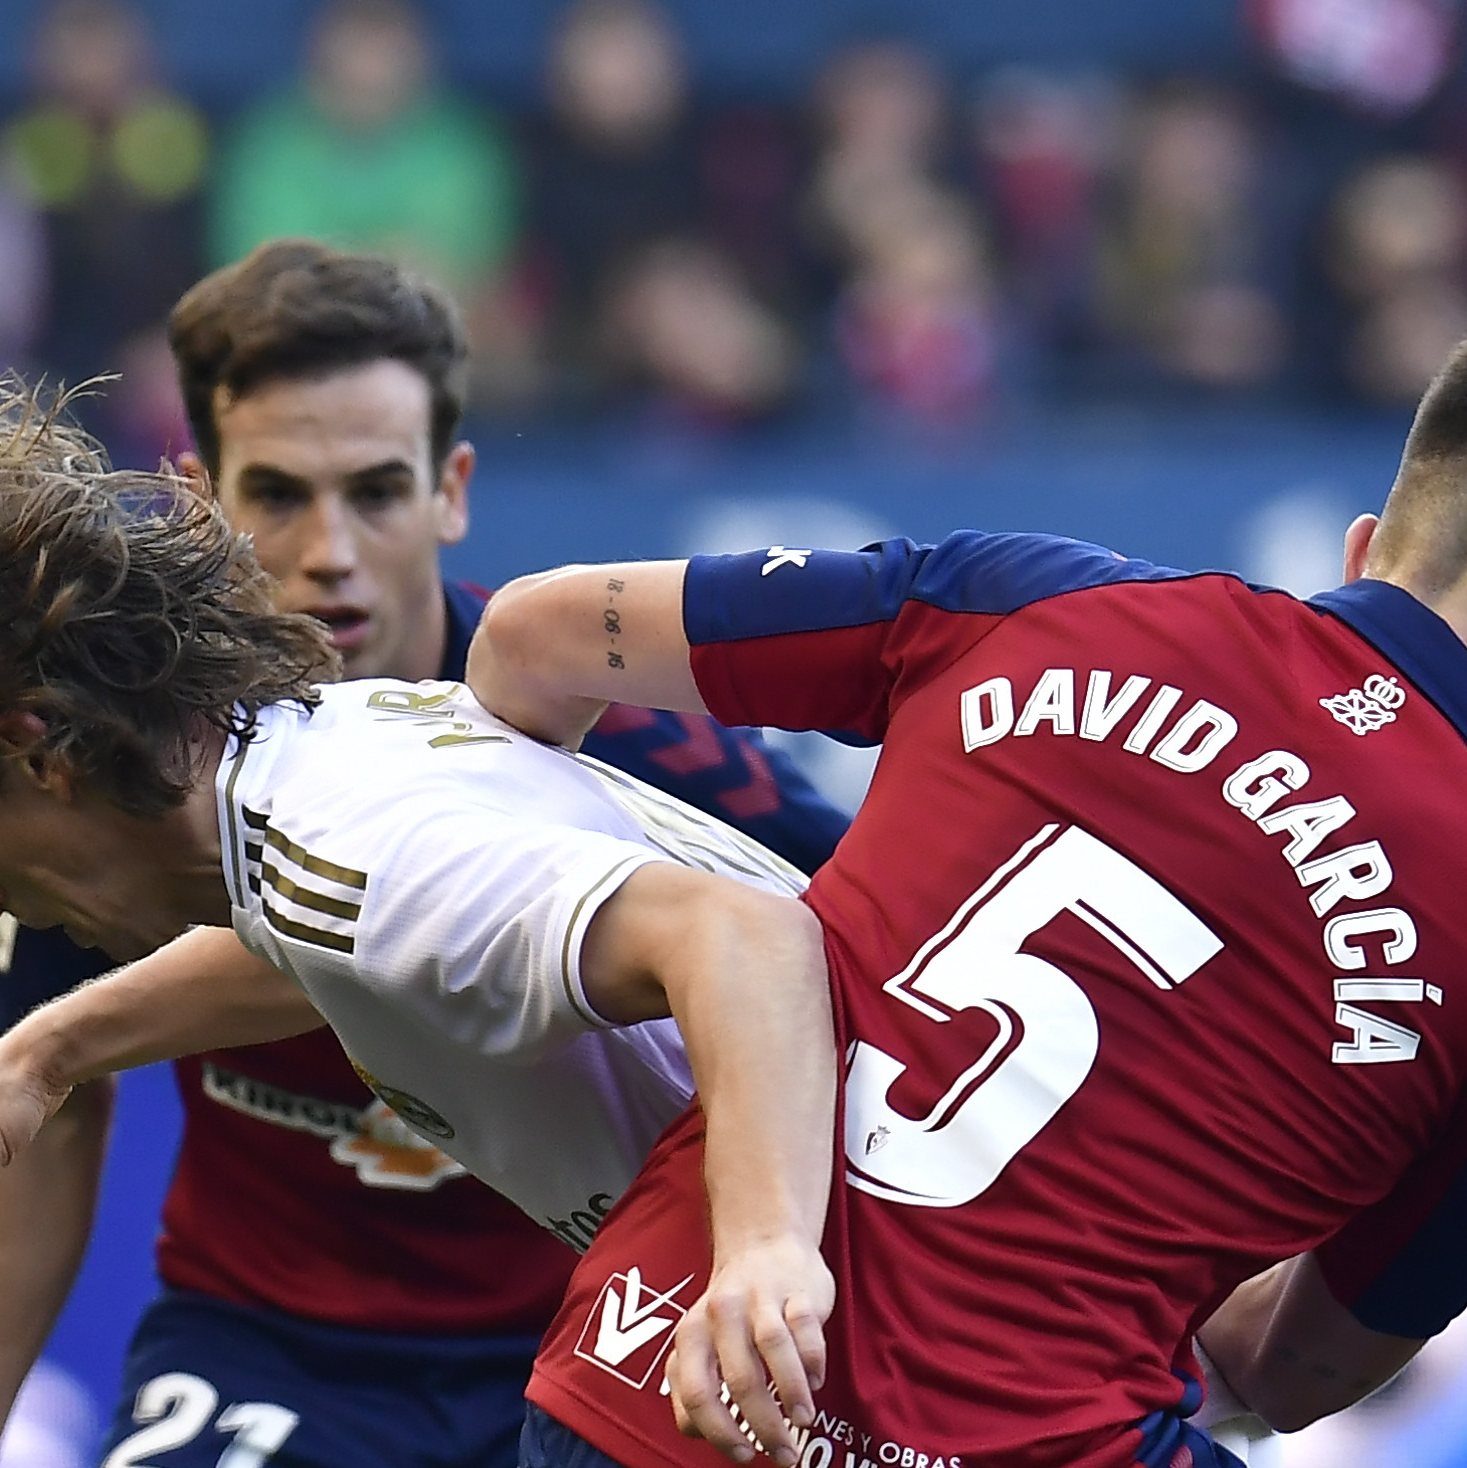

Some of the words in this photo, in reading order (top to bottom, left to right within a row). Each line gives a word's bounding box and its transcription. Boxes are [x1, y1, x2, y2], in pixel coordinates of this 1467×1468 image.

[844, 822, 1226, 1208] 5
[959, 667, 1239, 776] DAVID
[1221, 749, 1444, 1065] GARCÍA
